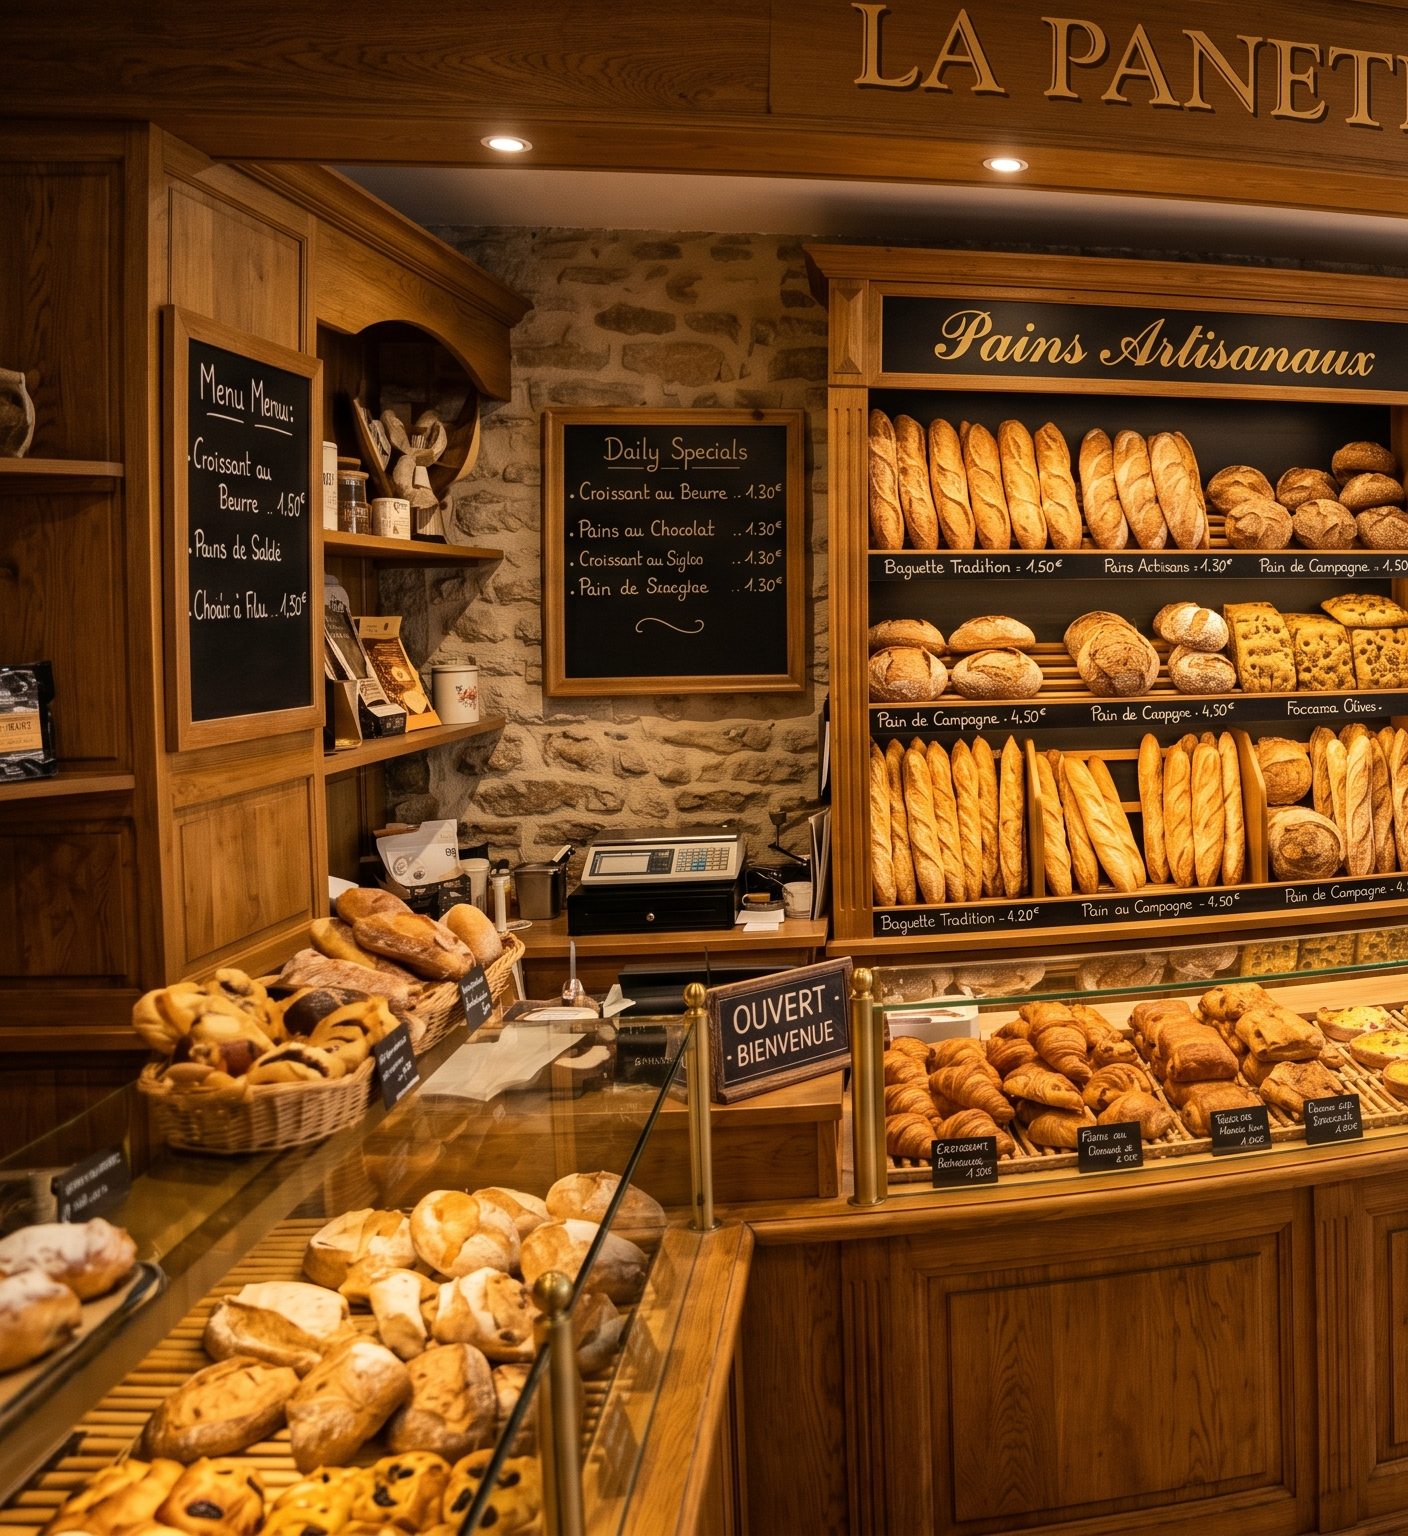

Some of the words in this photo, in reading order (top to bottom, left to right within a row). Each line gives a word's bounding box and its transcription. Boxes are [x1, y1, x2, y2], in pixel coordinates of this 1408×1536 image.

[851, 2, 1005, 94] LA
[933, 308, 1087, 364] Pains
[1099, 317, 1376, 378] Artisanaux
[200, 362, 245, 411] Menu
[193, 436, 252, 477] Croissant
[256, 464, 272, 483] au
[603, 436, 659, 473] Daily
[671, 436, 748, 470] Specials
[218, 482, 259, 513] Beurre
[579, 481, 651, 501] Croissant
[655, 489, 675, 500] au
[680, 482, 728, 500] Beurre
[745, 482, 782, 499] 1.30€
[578, 519, 619, 538] Pains
[624, 527, 644, 537] au
[651, 519, 715, 537] Chocolat
[745, 520, 782, 536] 1.30€
[233, 533, 247, 560] de
[579, 550, 643, 567] Croissant
[646, 556, 664, 566] au
[744, 549, 782, 565] 1.30€
[884, 558, 945, 580] Baguette
[950, 557, 1011, 574] Tradition
[1025, 558, 1063, 574] 1,50€
[1258, 557, 1286, 573] Pain
[1290, 558, 1306, 573] de
[578, 577, 611, 596] Pain
[620, 578, 639, 595] de
[744, 576, 783, 593] 1.30€
[877, 711, 907, 728] Pain
[911, 711, 929, 727] de
[933, 710, 1000, 730] Campagne
[1010, 707, 1047, 725] 4.50€
[1090, 705, 1118, 721] Pain
[1122, 706, 1138, 721] de
[1284, 888, 1308, 903] Pain
[1312, 886, 1326, 900] de
[1330, 885, 1387, 901] Campagne
[880, 914, 936, 936] Baguette
[939, 912, 995, 926] Tradition
[1007, 906, 1040, 923] 4.20€
[1081, 902, 1109, 918] Pain
[1114, 906, 1130, 915] au
[1134, 899, 1193, 917] Campagne
[733, 984, 826, 1035] OUVERT
[737, 1020, 834, 1068] BIENVENUE
